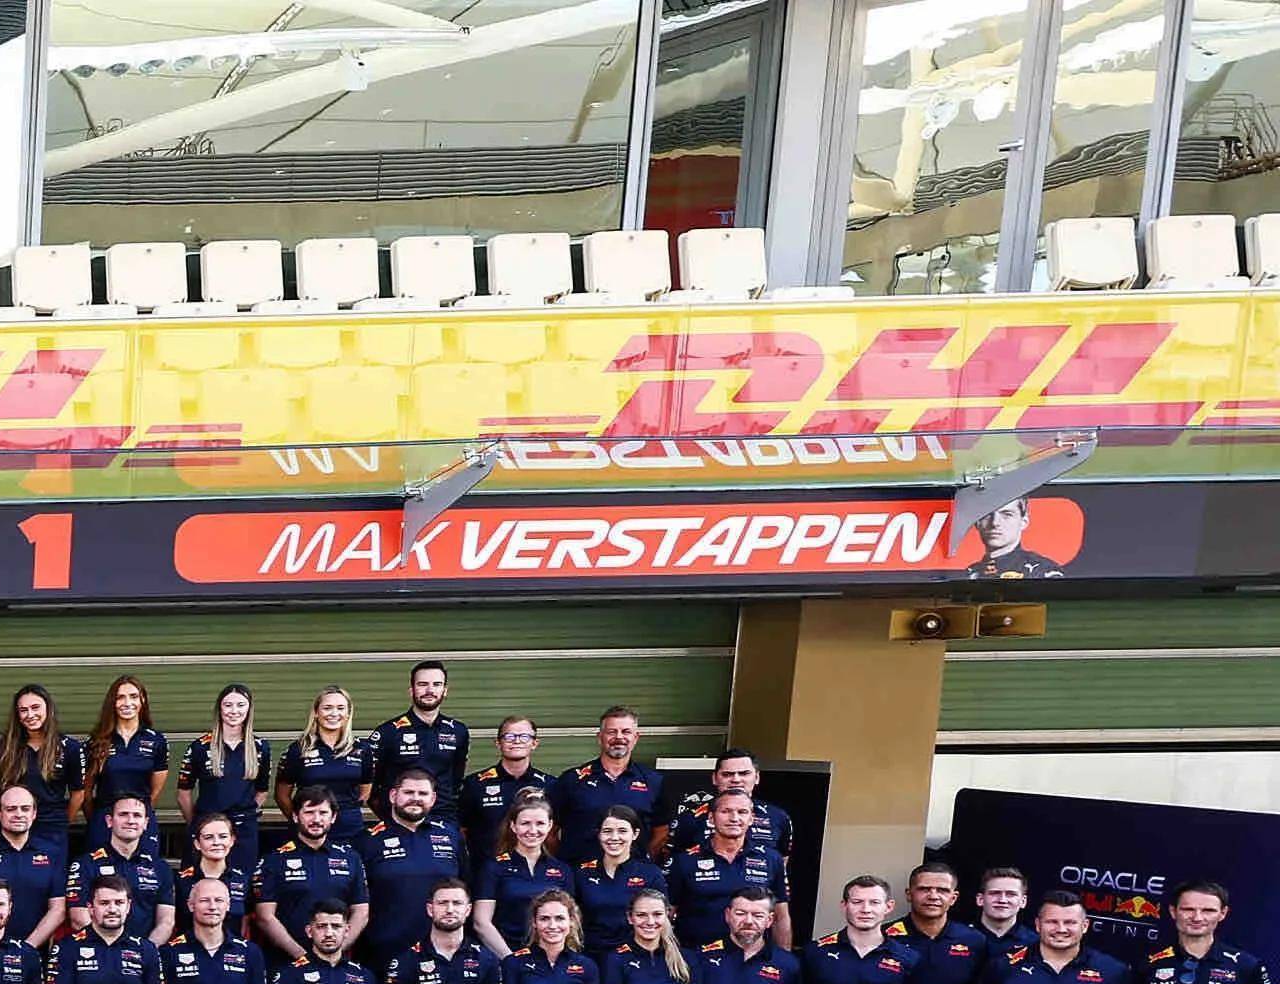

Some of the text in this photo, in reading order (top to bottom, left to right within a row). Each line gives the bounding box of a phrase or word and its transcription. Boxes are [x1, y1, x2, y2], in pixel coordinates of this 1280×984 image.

[586, 323, 1202, 447] DHL
[18, 513, 73, 589] 1
[459, 512, 947, 570] VERSTAPPEN
[1060, 865, 1166, 895] ORACLE
[1092, 920, 1160, 941] CING
